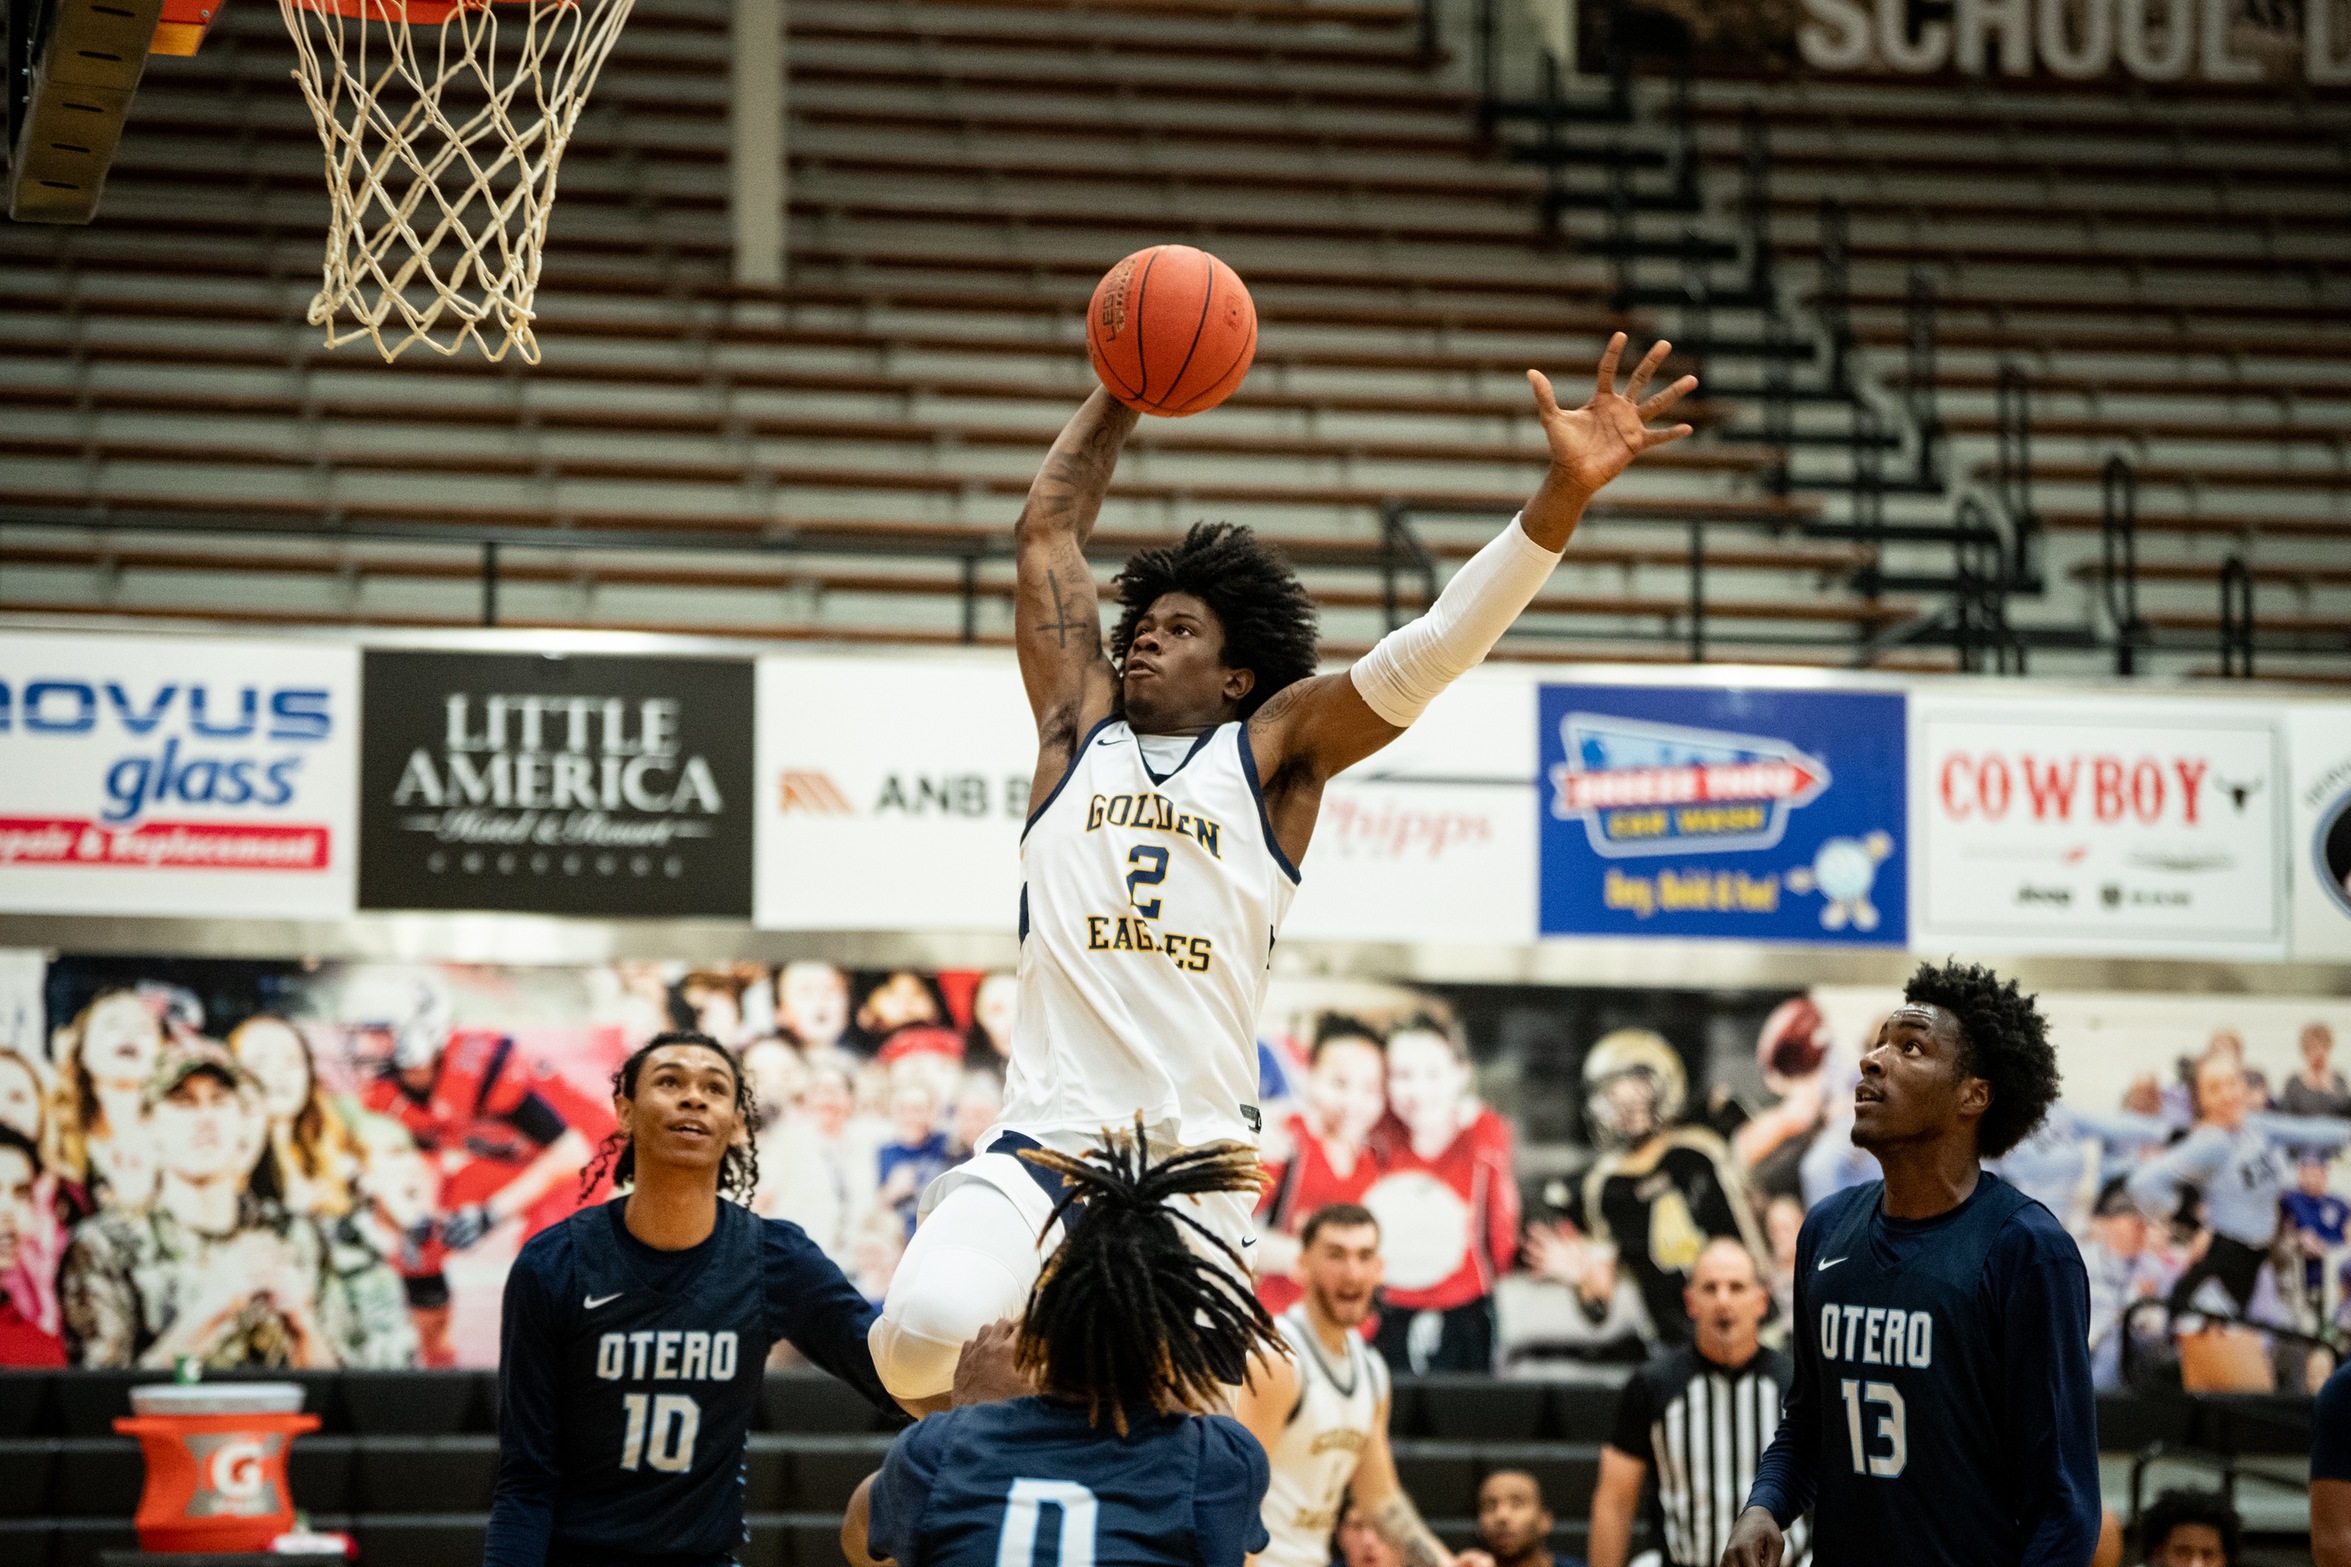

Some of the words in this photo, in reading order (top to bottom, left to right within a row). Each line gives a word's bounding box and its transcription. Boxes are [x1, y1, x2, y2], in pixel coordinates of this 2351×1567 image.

[446, 693, 682, 757] LITTLE
[101, 737, 303, 822] glass
[393, 749, 724, 815] AMERICA
[873, 771, 988, 820] ANB
[1939, 752, 2208, 828] COWBOY
[1087, 793, 1222, 861] GOLDEN
[1126, 844, 1170, 920] 2
[1087, 915, 1212, 972] EAGES
[597, 1330, 738, 1381] OTERO
[1821, 1303, 1933, 1369] OTERO
[620, 1393, 700, 1473] 10
[1841, 1378, 1907, 1479] 13
